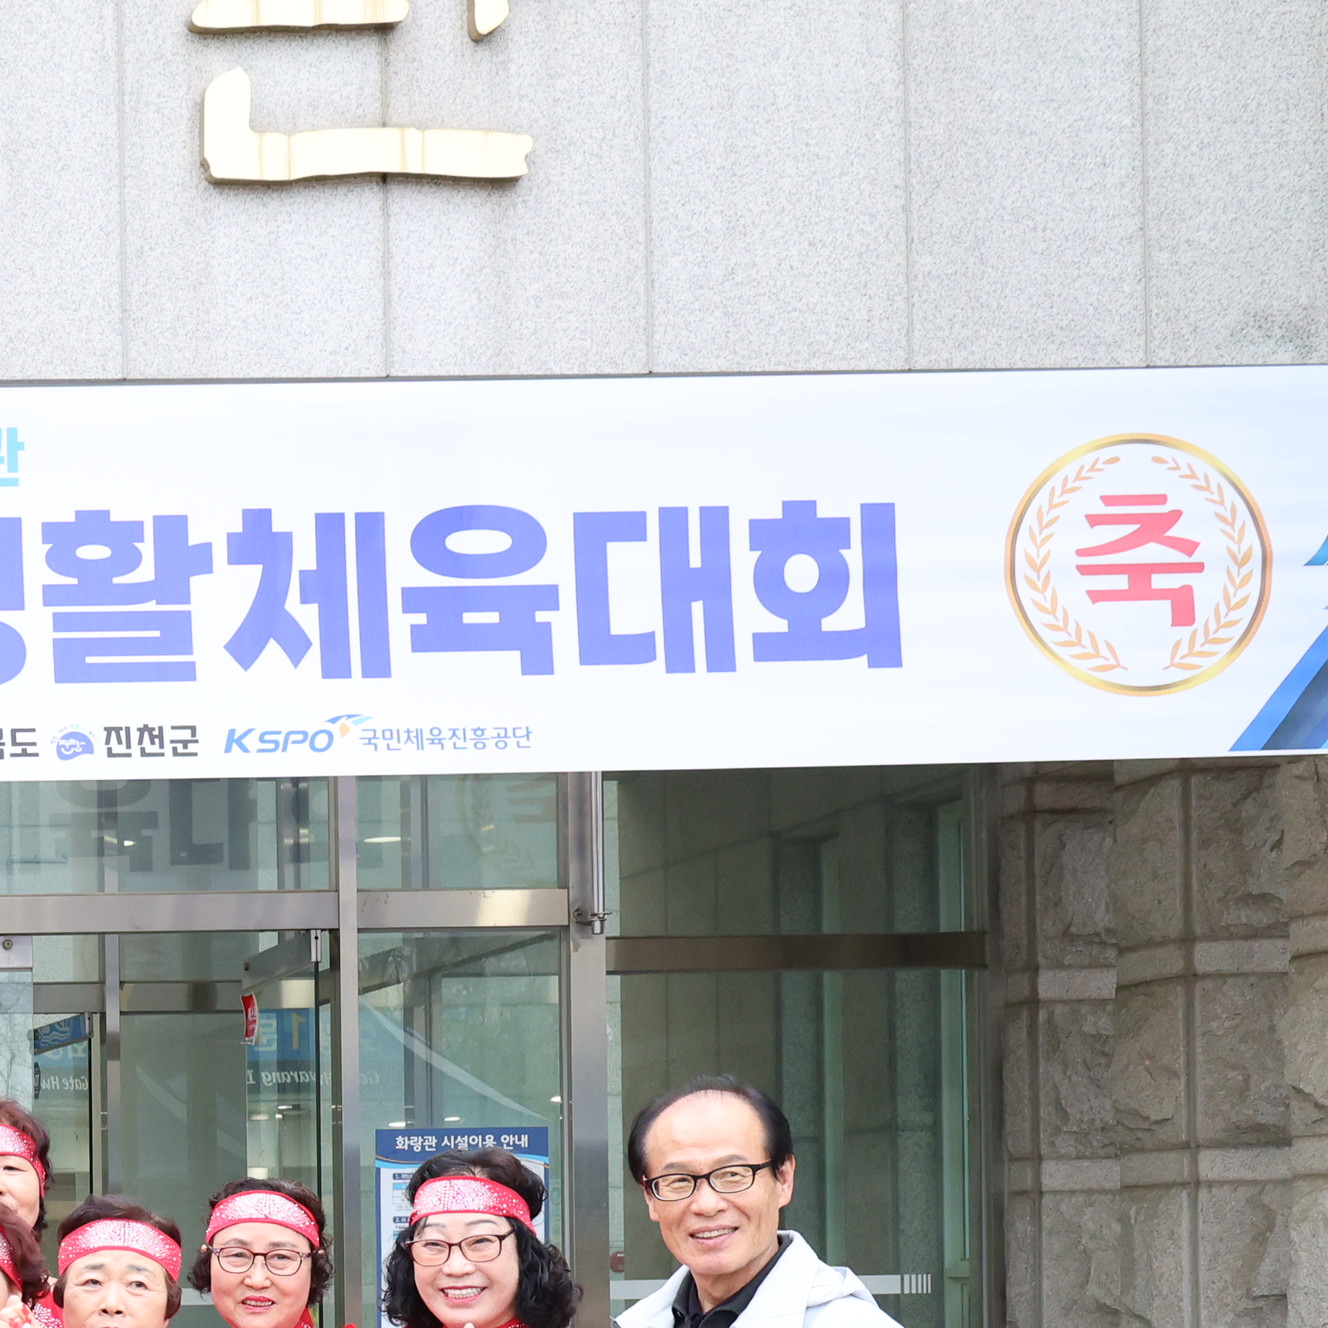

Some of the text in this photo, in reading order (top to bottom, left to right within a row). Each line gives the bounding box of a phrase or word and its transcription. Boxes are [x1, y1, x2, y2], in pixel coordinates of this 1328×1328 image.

[1075, 493, 1205, 627] 축
[103, 723, 199, 758] 진천군
[224, 726, 334, 754] KSPO
[357, 722, 532, 751] 국민체육진흥공단
[394, 1133, 529, 1153] 화랑관 시설이용 안내
